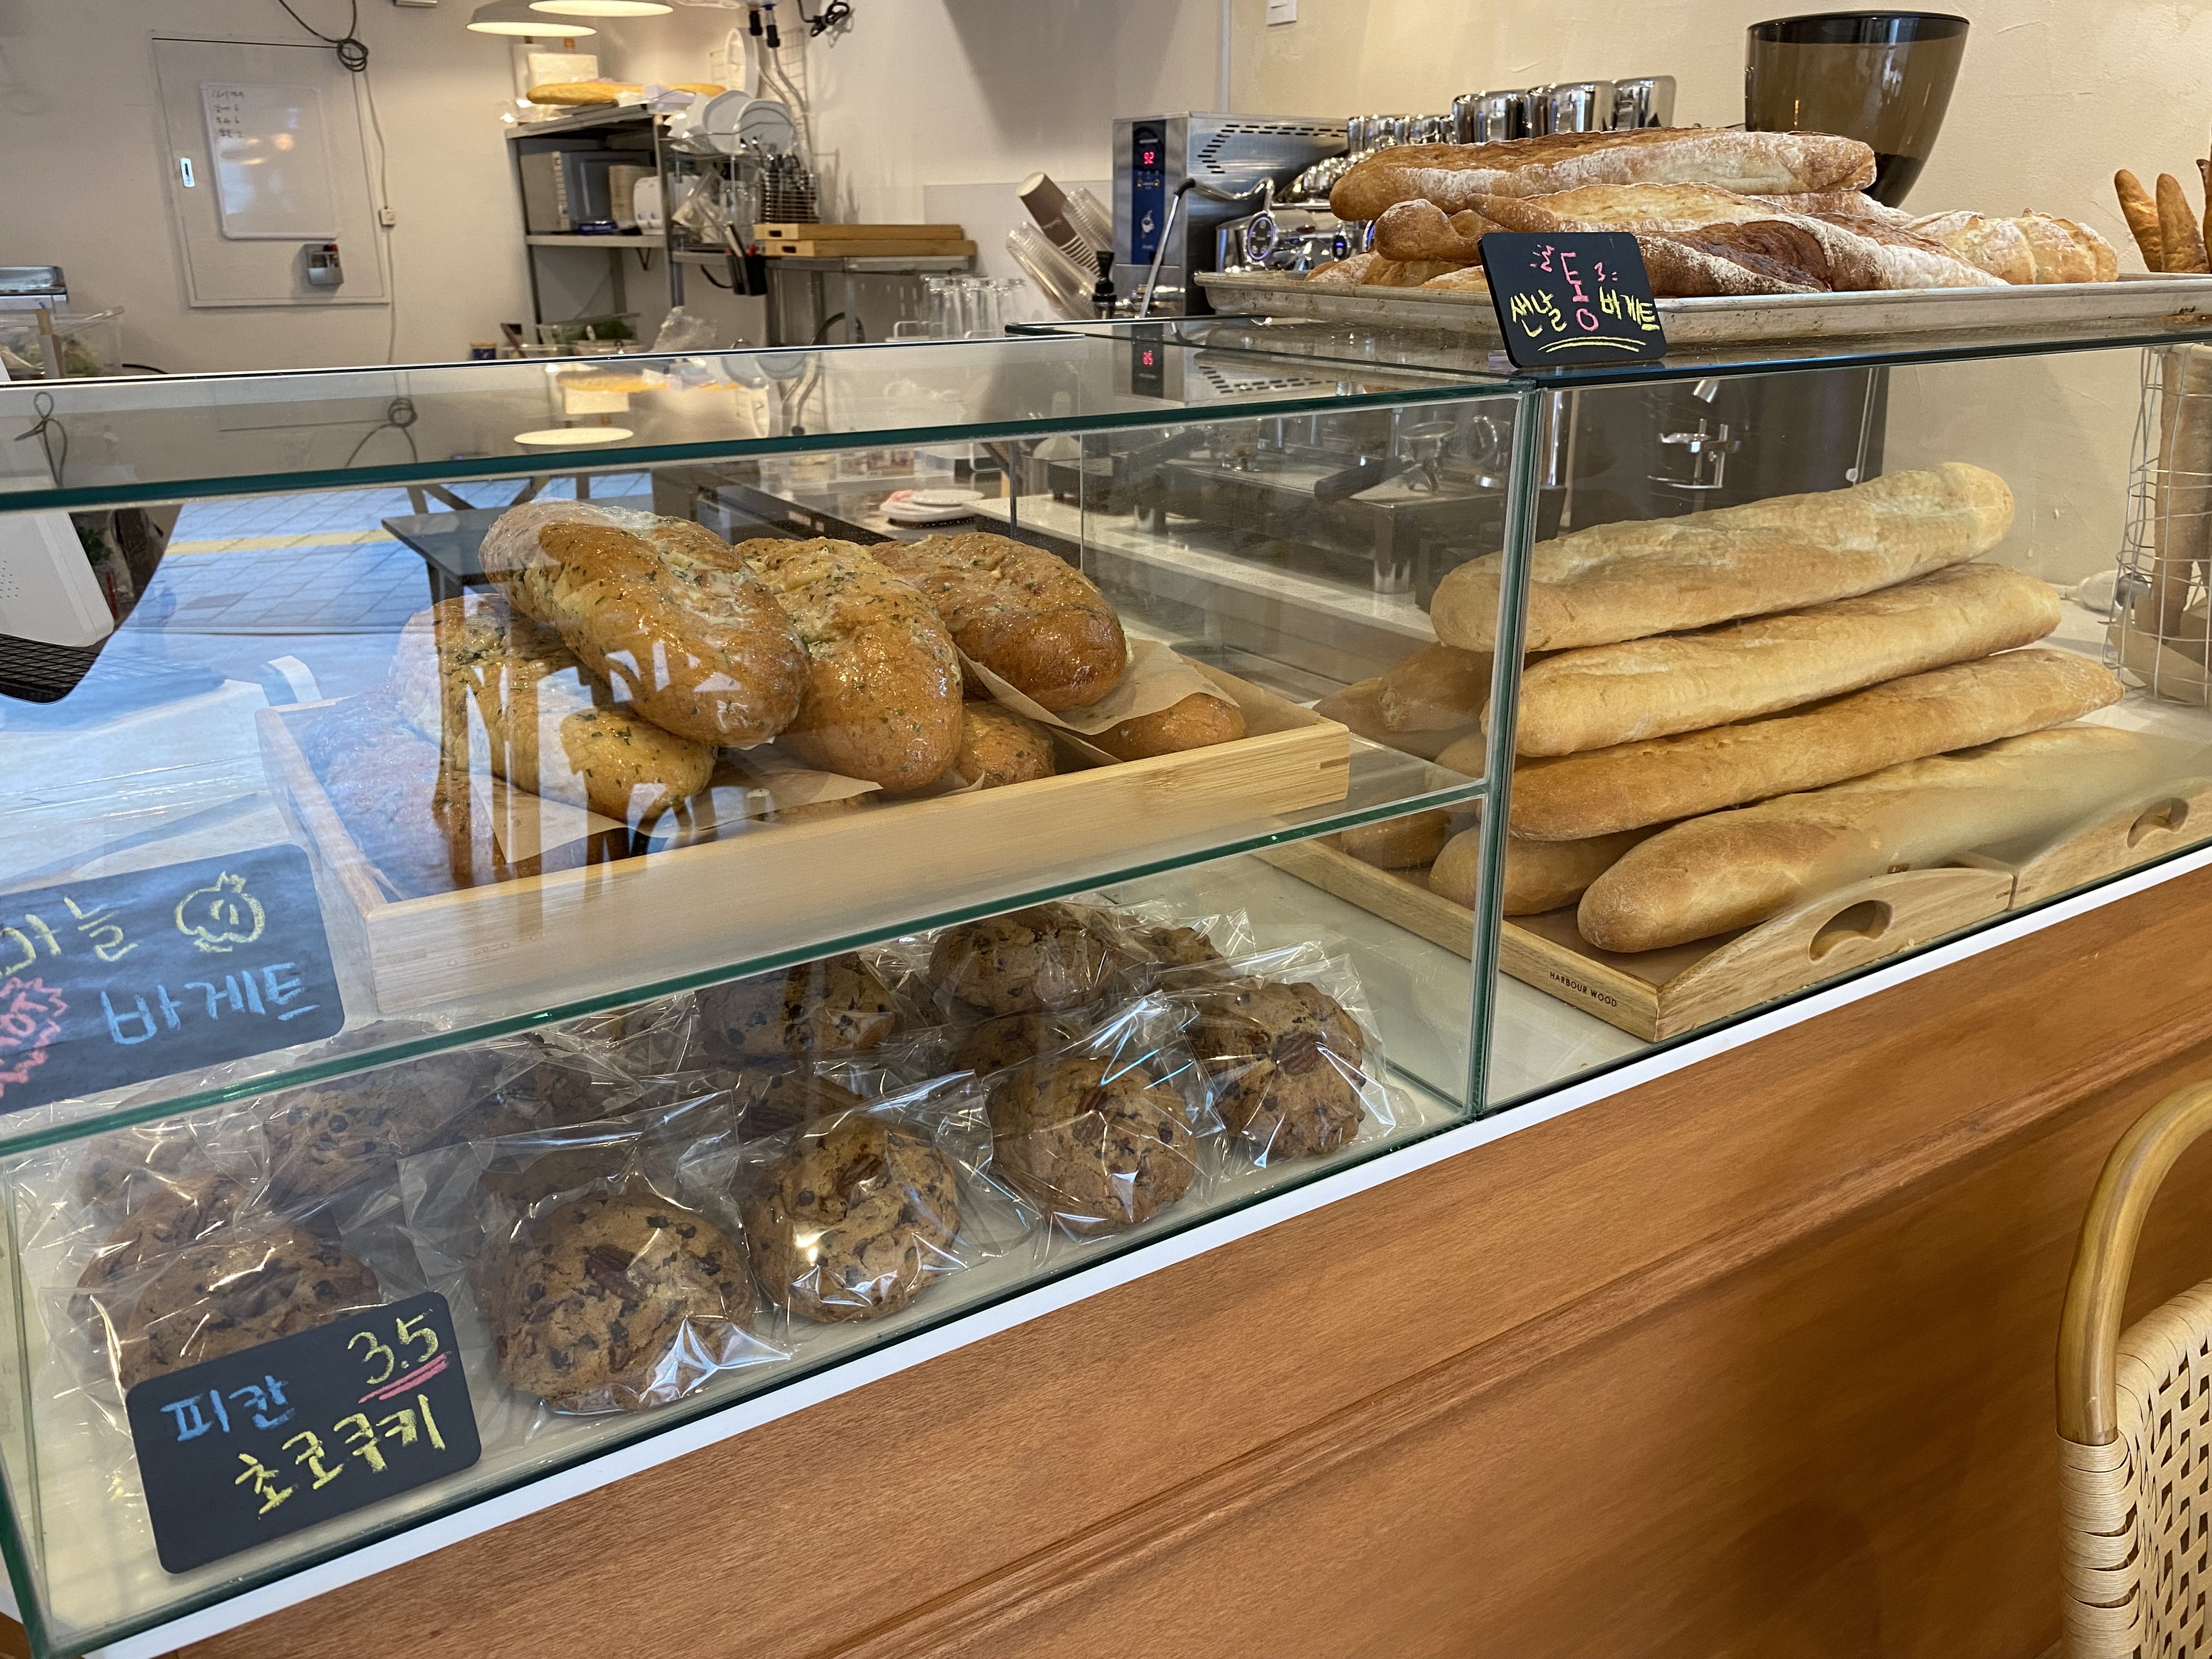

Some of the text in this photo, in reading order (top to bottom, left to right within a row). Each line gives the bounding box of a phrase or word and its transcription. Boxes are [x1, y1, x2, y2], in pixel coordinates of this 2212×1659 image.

[0, 896, 139, 977] 마늘
[100, 962, 321, 1045] 바게트
[1549, 971, 1617, 1007] HARBOUR WOOD
[347, 1308, 439, 1385] 3.5
[160, 1375, 297, 1442] 피칸
[234, 1393, 446, 1515] 초코쿠키
